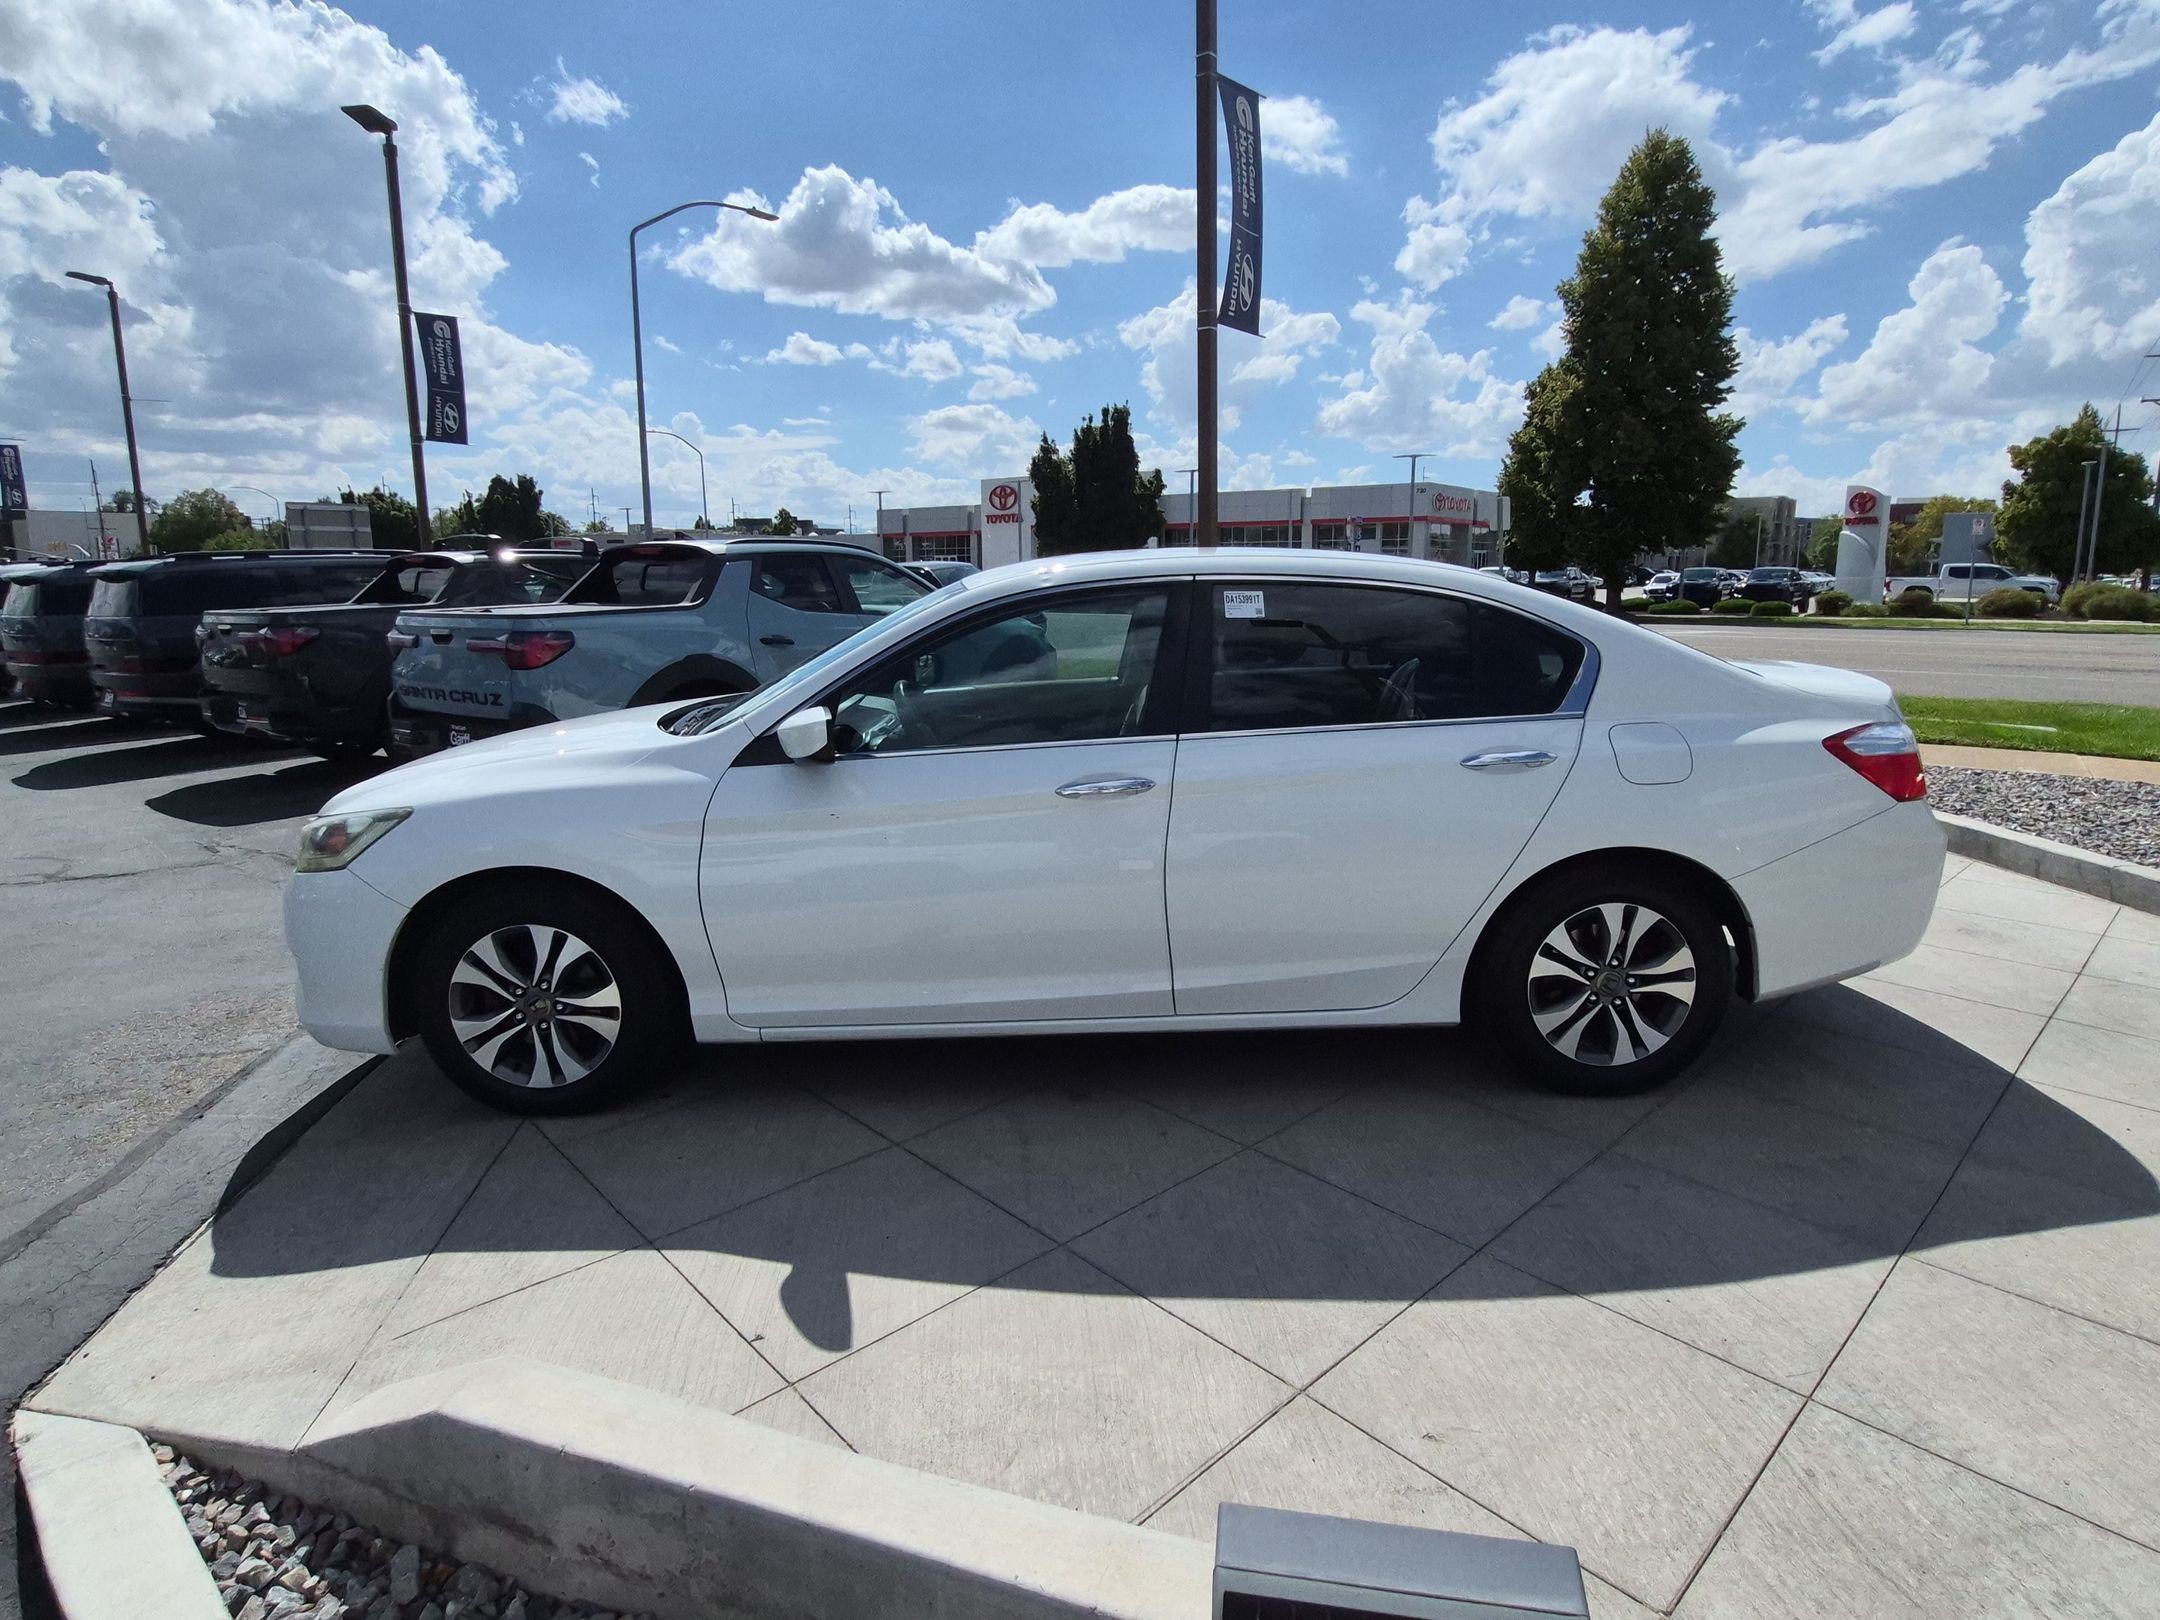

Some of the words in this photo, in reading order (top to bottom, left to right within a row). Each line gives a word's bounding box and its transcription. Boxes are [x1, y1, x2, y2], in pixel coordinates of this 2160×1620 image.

[1247, 134, 1255, 164] Ken
[1238, 129, 1250, 218] Hyundai
[1228, 239, 1242, 317] HYUNDAI
[434, 338, 450, 385] Hyundai
[434, 395, 443, 437] HYUNDAI
[985, 513, 1024, 525] TOYOTA
[1445, 495, 1472, 513] TOYOTA
[448, 689, 504, 706] CRUZ
